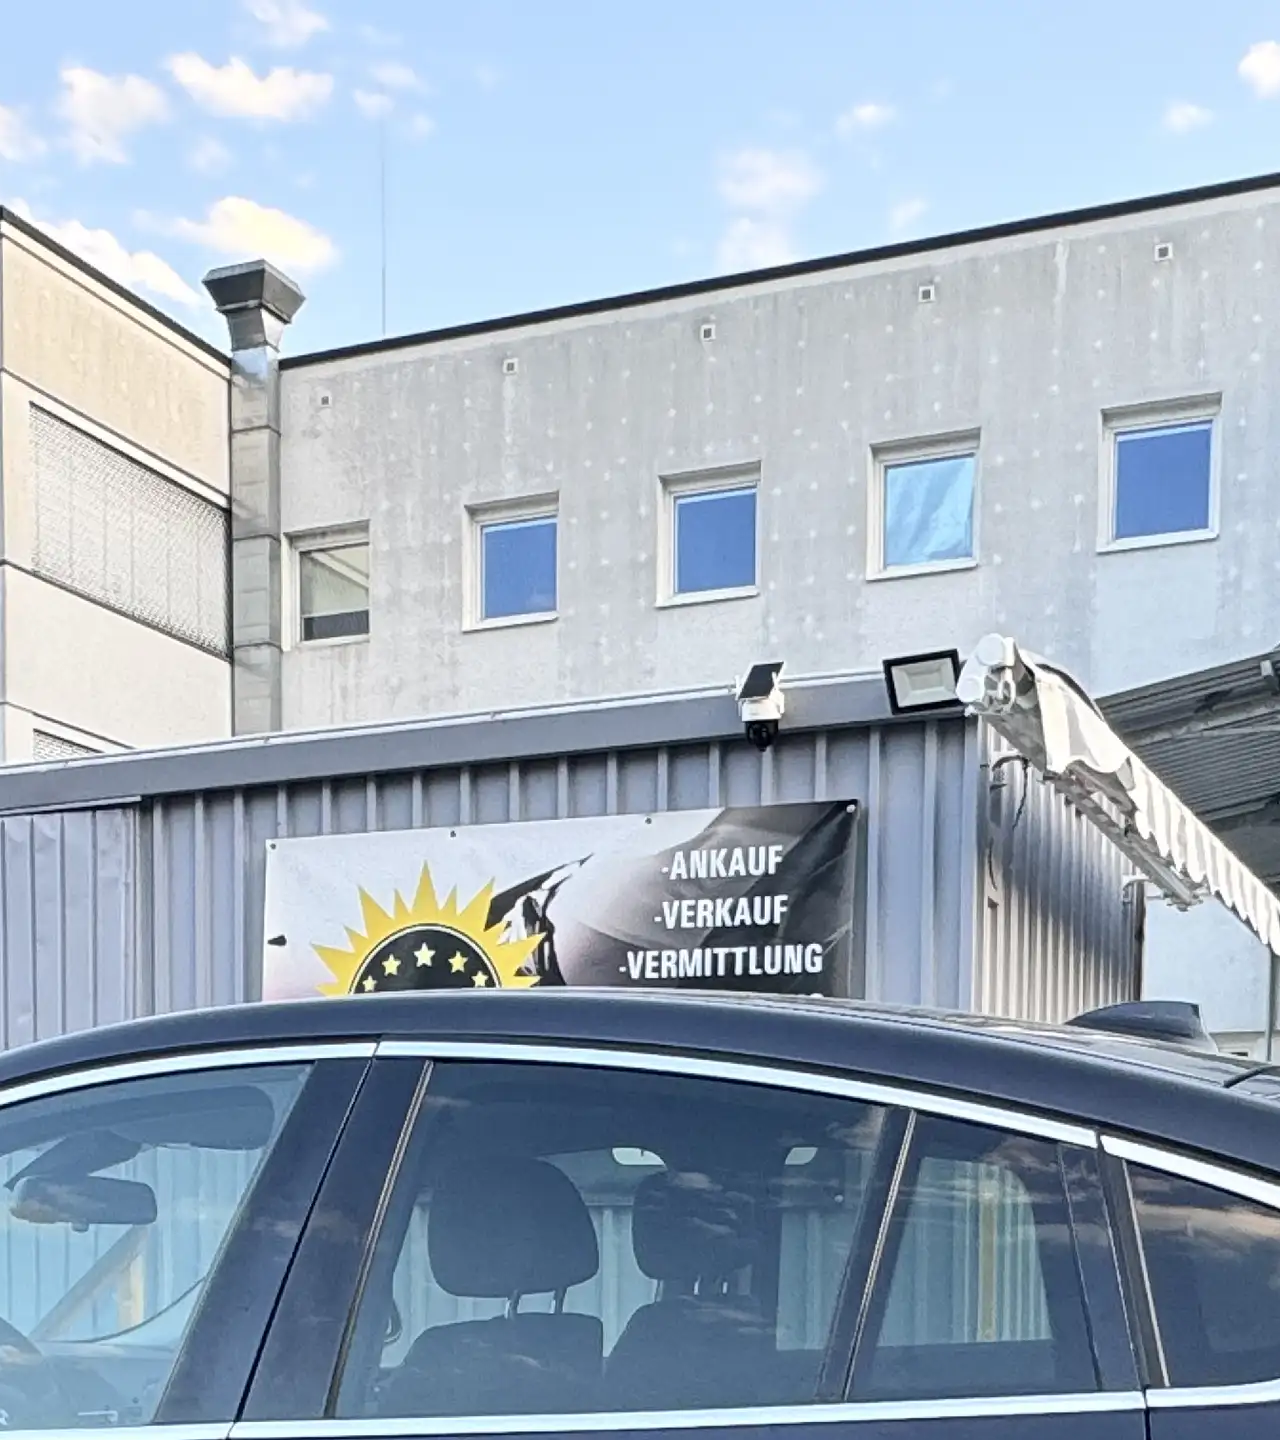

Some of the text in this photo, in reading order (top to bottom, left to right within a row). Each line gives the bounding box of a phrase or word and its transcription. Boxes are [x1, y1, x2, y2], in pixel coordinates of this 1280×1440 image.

[661, 845, 784, 880] -ANKAUF
[654, 895, 789, 929] -VERKAUF
[619, 943, 823, 980] -VERMITTLUNG
